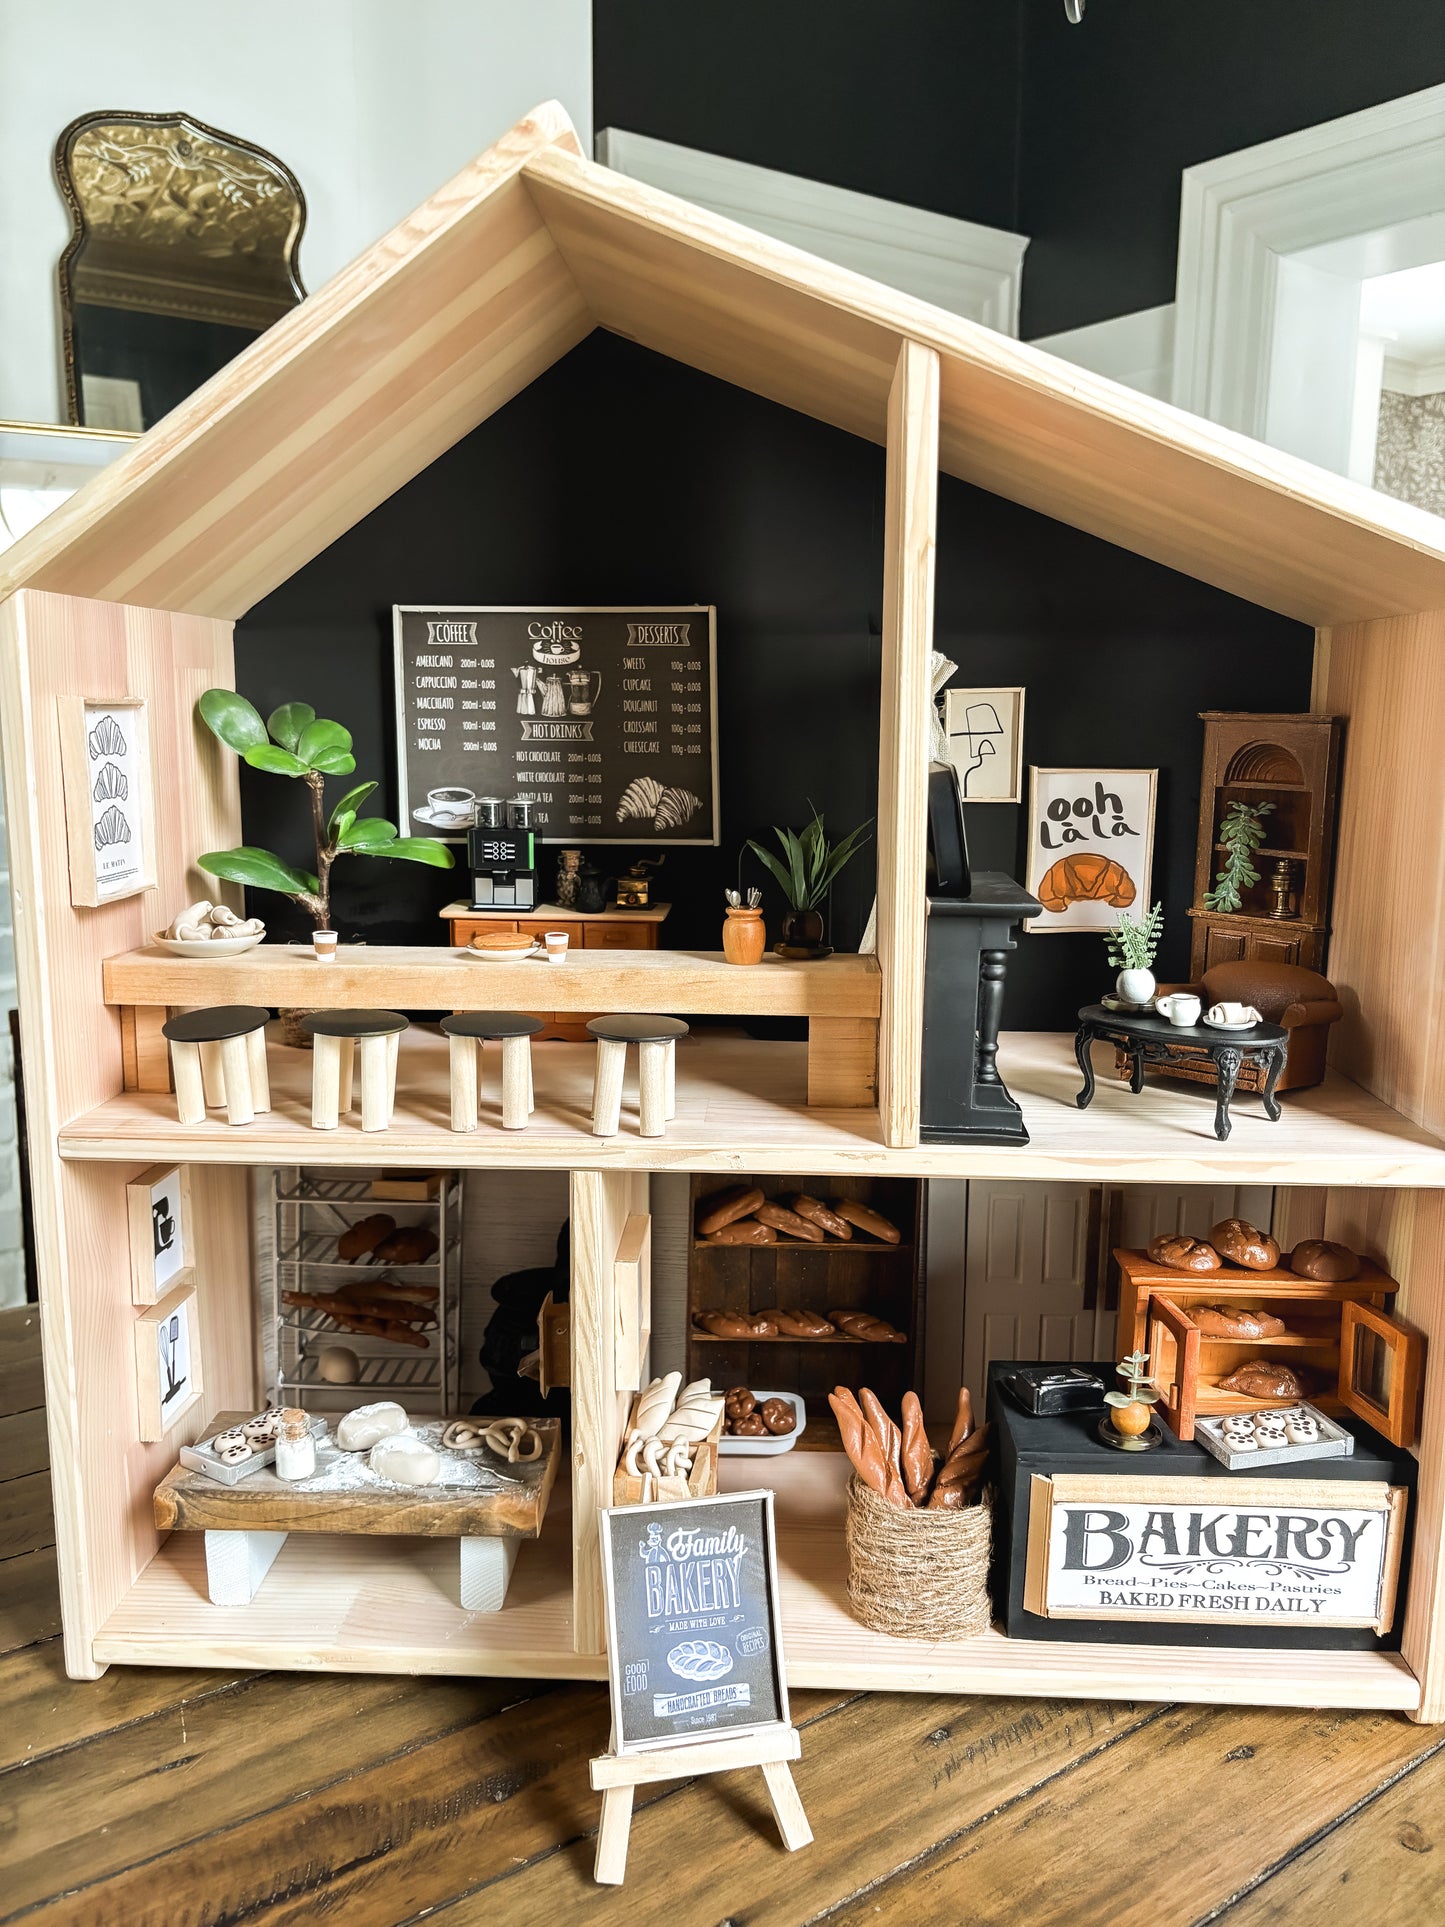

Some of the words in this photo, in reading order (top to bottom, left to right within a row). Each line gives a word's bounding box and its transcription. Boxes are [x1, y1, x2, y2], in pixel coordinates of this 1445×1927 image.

[436, 624, 469, 643] COFFEE
[527, 620, 583, 643] Coffee
[638, 625, 679, 644] DESSERTS
[415, 655, 454, 668] AMERICANO
[623, 657, 646, 670] SWEETS
[416, 676, 458, 689] CAPPUCCINO
[623, 678, 652, 691] CUPCAKE
[416, 697, 455, 710] MACCHIATO
[623, 699, 658, 713] DOUGHNUT
[417, 718, 446, 731] ESPRESSO
[623, 721, 658, 733] CROISSANT
[532, 724, 549, 738] HOT
[550, 724, 583, 739] DRINKS
[418, 738, 441, 751] MOCHA
[623, 741, 660, 754] CHEESECAKE
[516, 751, 528, 762] HOT
[528, 751, 561, 762] CHOCOLATE
[516, 772, 535, 783] WHITE
[535, 772, 566, 783] CHOCOLATE
[542, 792, 553, 804] TEA
[1047, 781, 1124, 822] ooh
[538, 812, 549, 824] TEA
[666, 1525, 749, 1562] Family
[1062, 1509, 1373, 1572] BAKERY
[645, 1556, 743, 1618] BAKERY
[1099, 1590, 1174, 1608] BAKED
[1177, 1593, 1249, 1611] FRESH
[1254, 1596, 1327, 1614] DAILY
[669, 1622, 689, 1632] MADE
[689, 1619, 708, 1629] WITH
[709, 1616, 726, 1626] LOVE
[625, 1663, 647, 1676] GOOD
[626, 1674, 648, 1692] FOOD
[667, 1691, 711, 1714] HANDCRAFTED
[713, 1686, 737, 1702] BREADS
